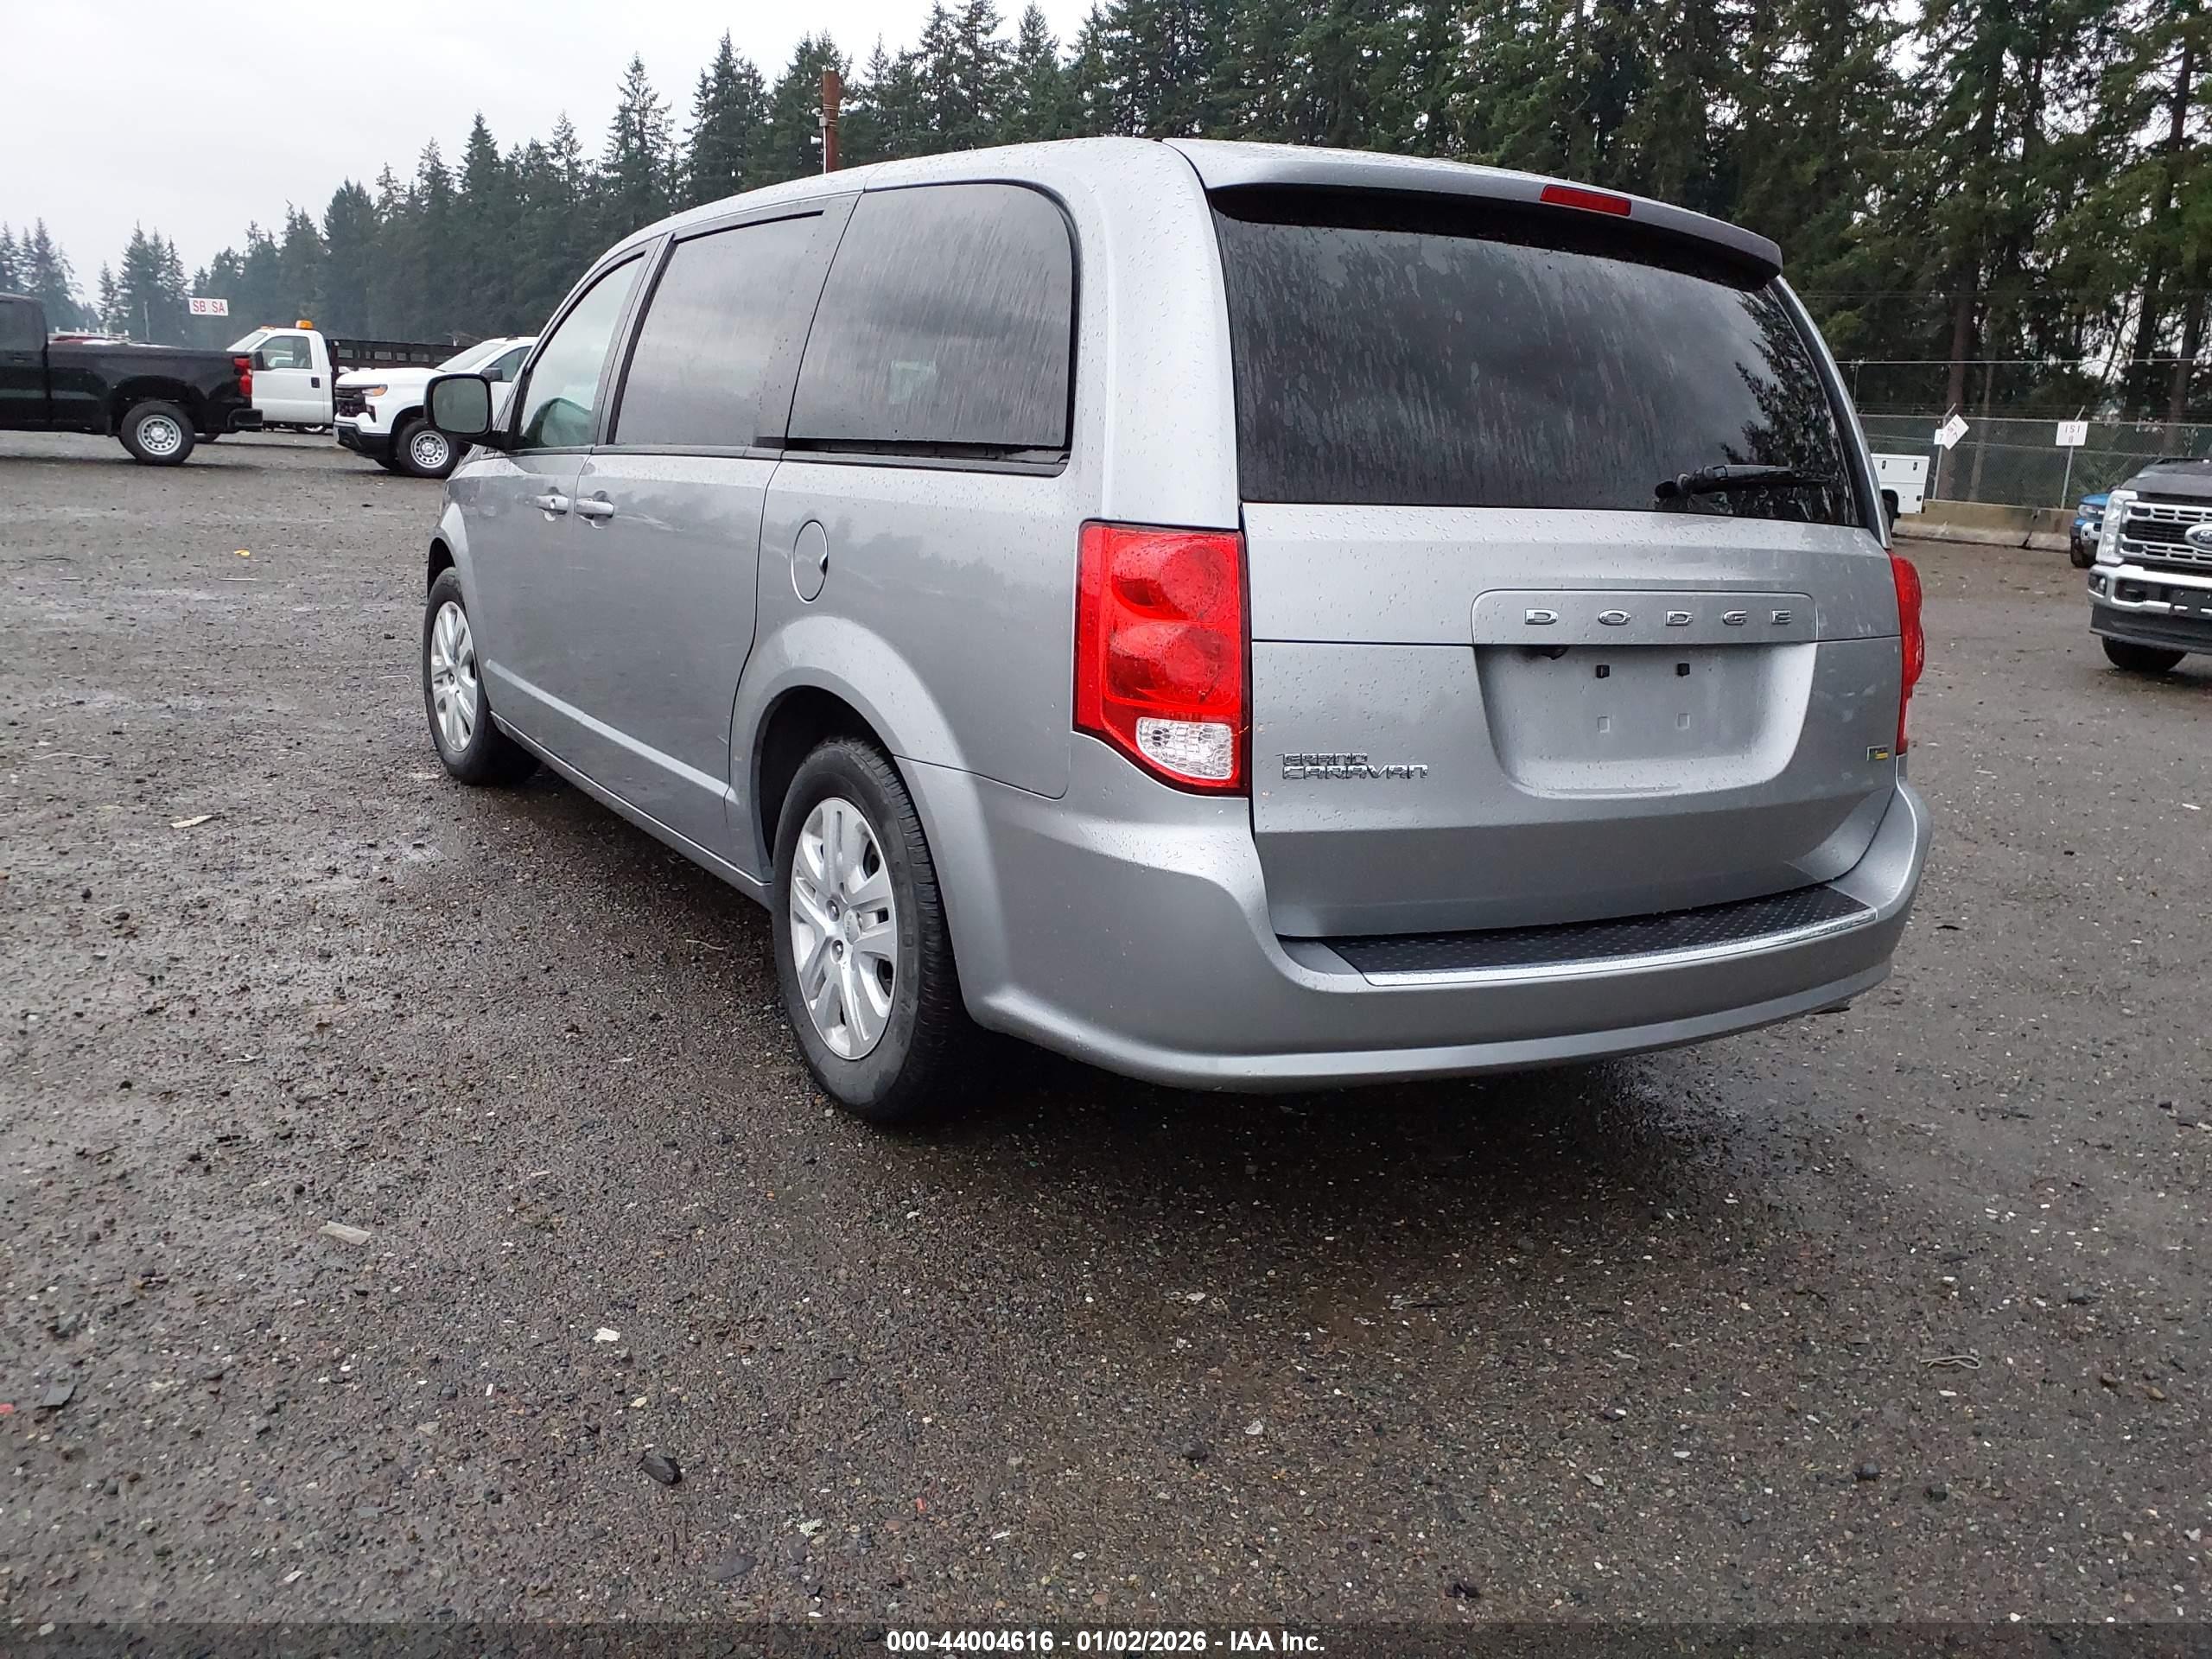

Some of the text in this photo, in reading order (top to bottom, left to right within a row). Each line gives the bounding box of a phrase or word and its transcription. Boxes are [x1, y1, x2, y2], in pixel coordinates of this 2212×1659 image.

[193, 300, 226, 313] SB SA
[1523, 607, 1792, 626] DODGE
[1282, 753, 1368, 766] GRAND
[1282, 765, 1429, 780] CARAVAN
